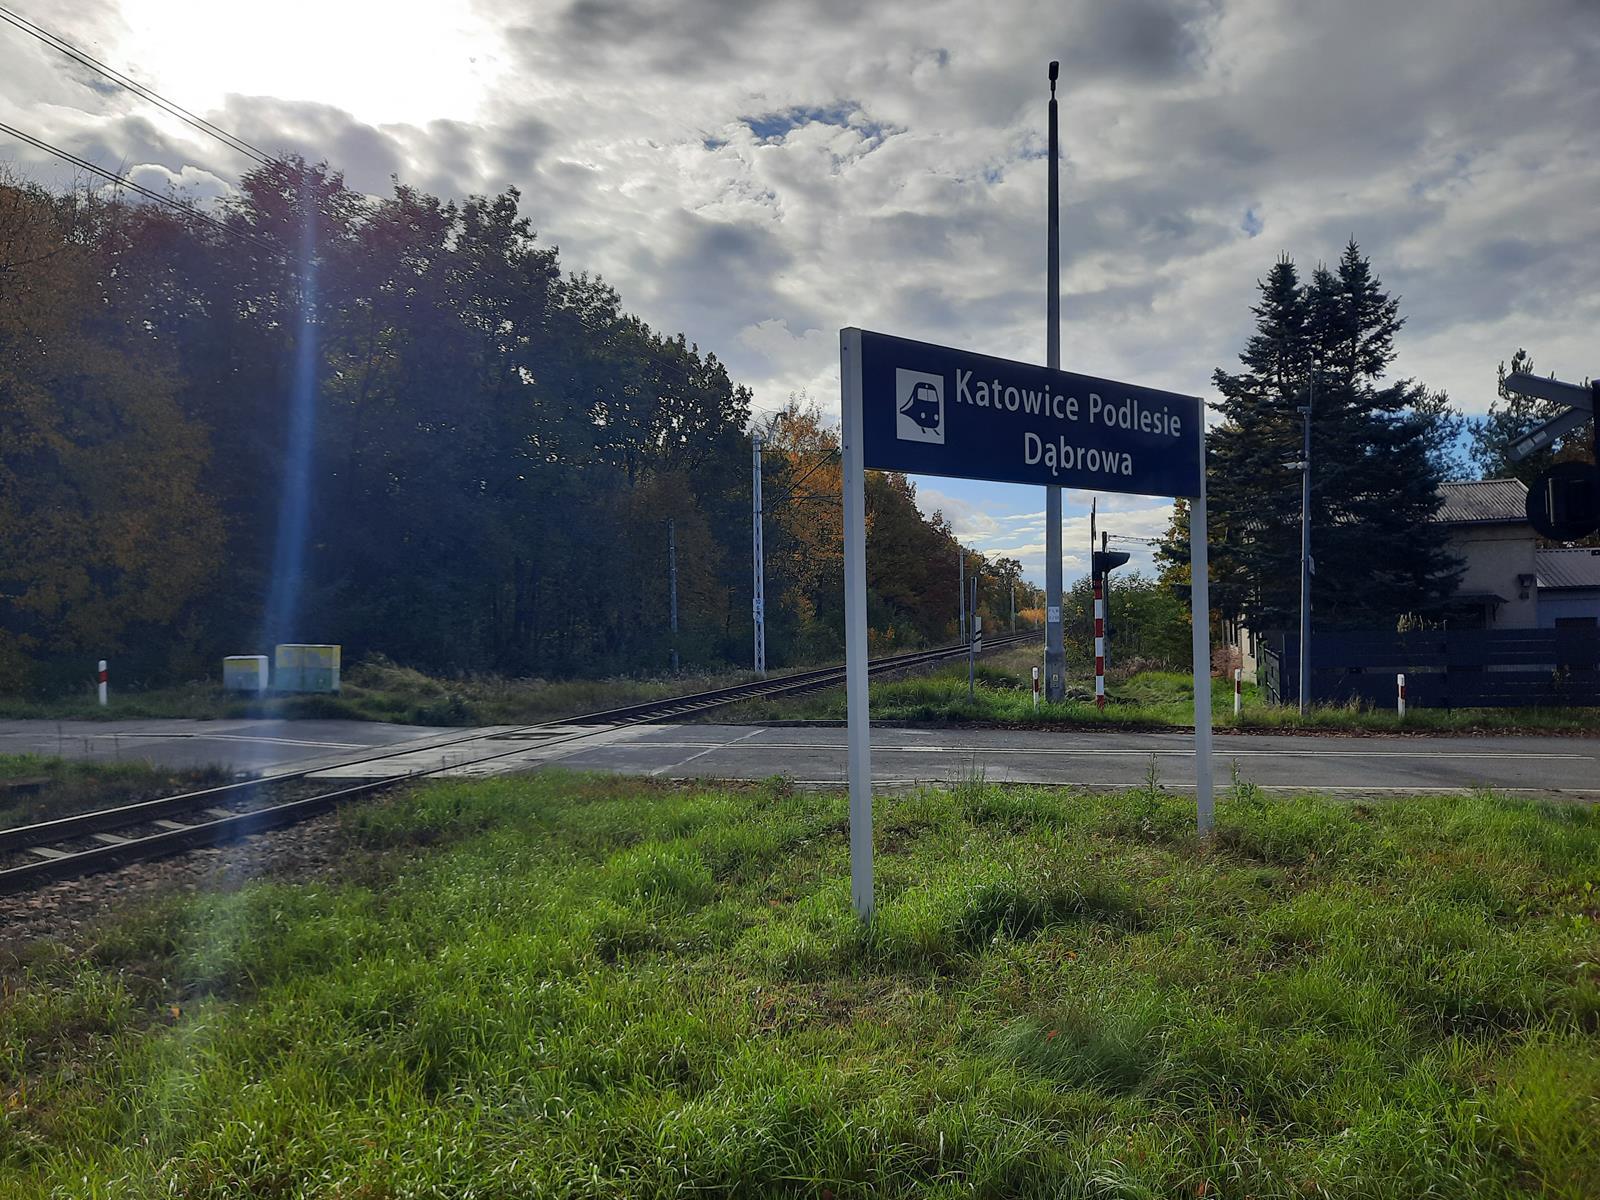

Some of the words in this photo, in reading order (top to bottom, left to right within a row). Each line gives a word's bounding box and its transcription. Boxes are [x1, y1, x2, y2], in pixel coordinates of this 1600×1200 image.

[955, 368, 1079, 421] Katowice
[1089, 392, 1181, 437] Podlesie
[1024, 432, 1133, 476] Dąbrowa
